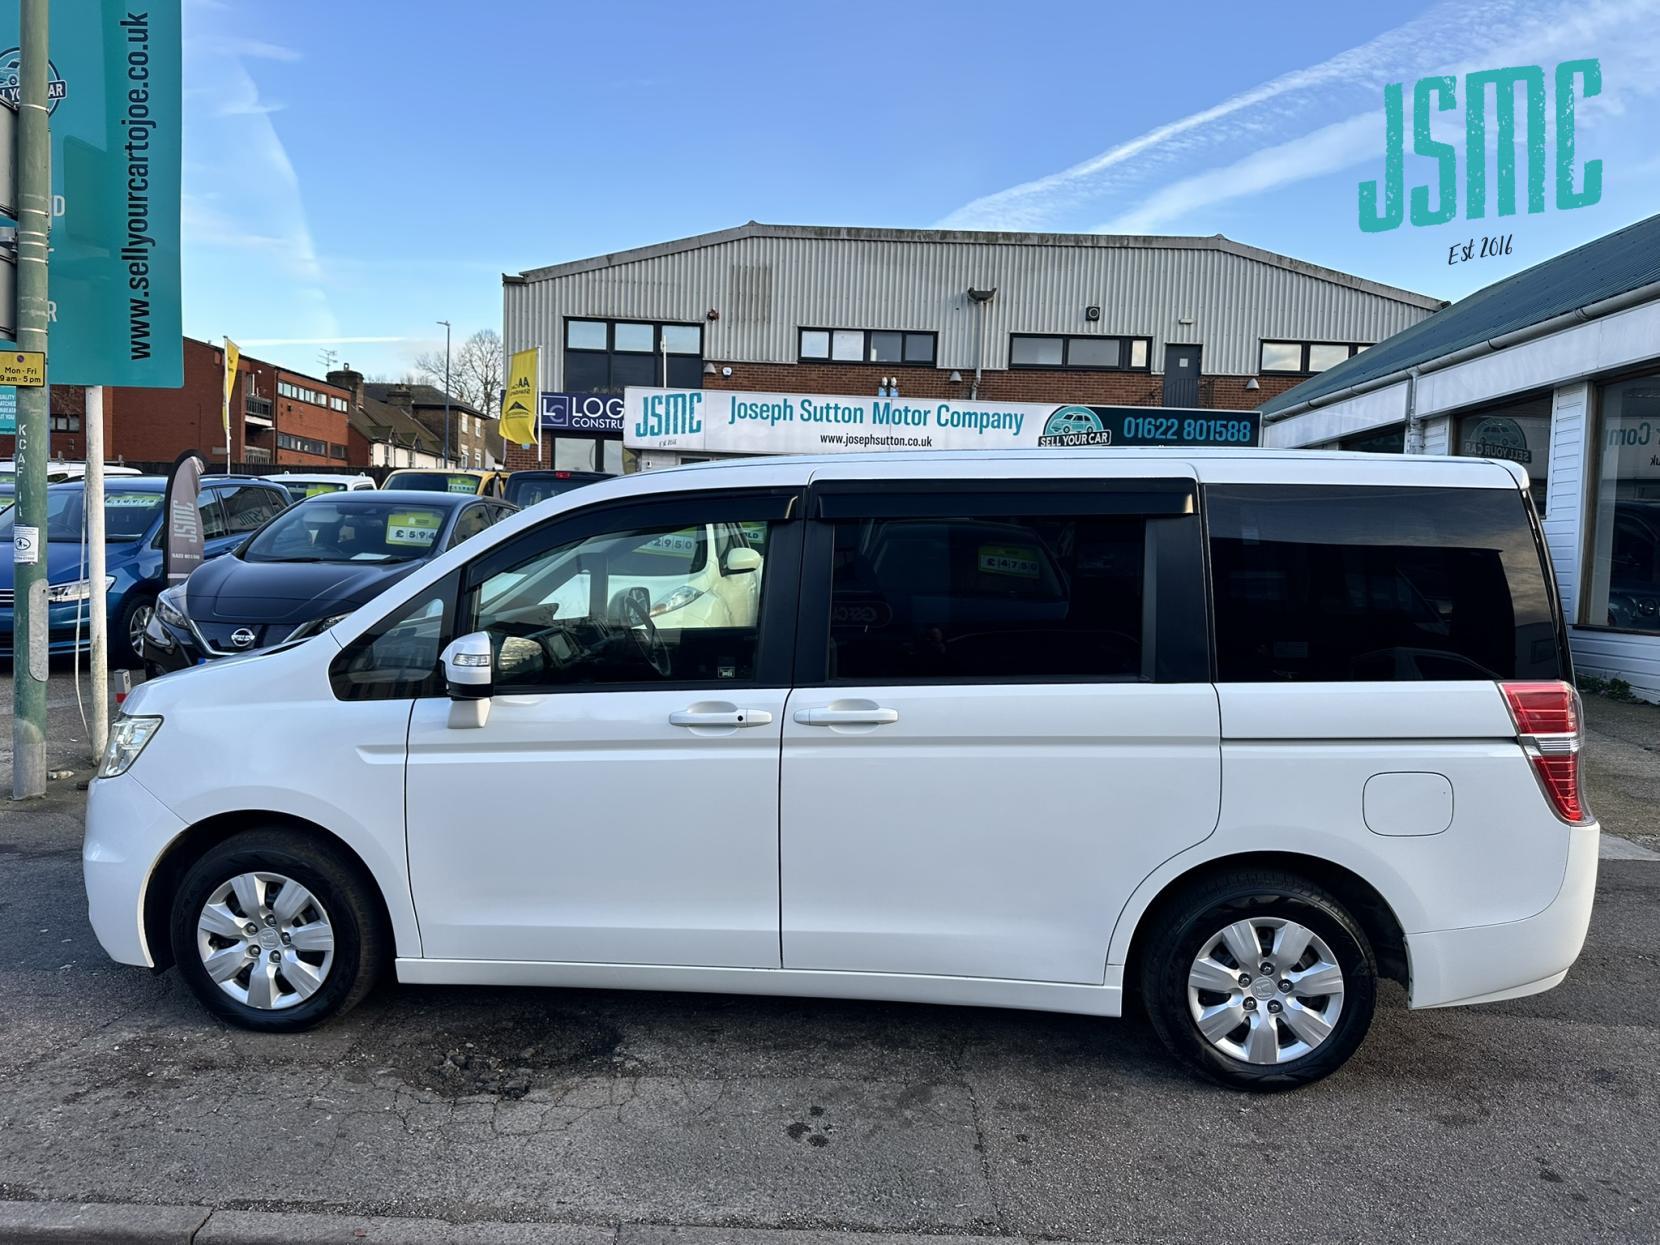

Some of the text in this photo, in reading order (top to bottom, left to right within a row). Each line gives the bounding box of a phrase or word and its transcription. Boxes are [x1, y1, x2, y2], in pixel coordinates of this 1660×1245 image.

[48, 84, 63, 97] AR
[120, 11, 156, 361] www.sellyourcartojoe.co.uk
[29, 376, 41, 384] pm
[572, 396, 624, 419] LOG
[635, 392, 702, 438] JSMC
[728, 396, 1024, 436] Joseph Sutton Motor Company
[572, 417, 624, 430] CONSTRU
[1123, 416, 1250, 442] 01622 801588
[820, 433, 933, 448] www.josephsutton.co.uk
[1040, 432, 1108, 447] SELL YOUR CAR
[173, 500, 198, 543] JSMC
[653, 538, 693, 549] 2950
